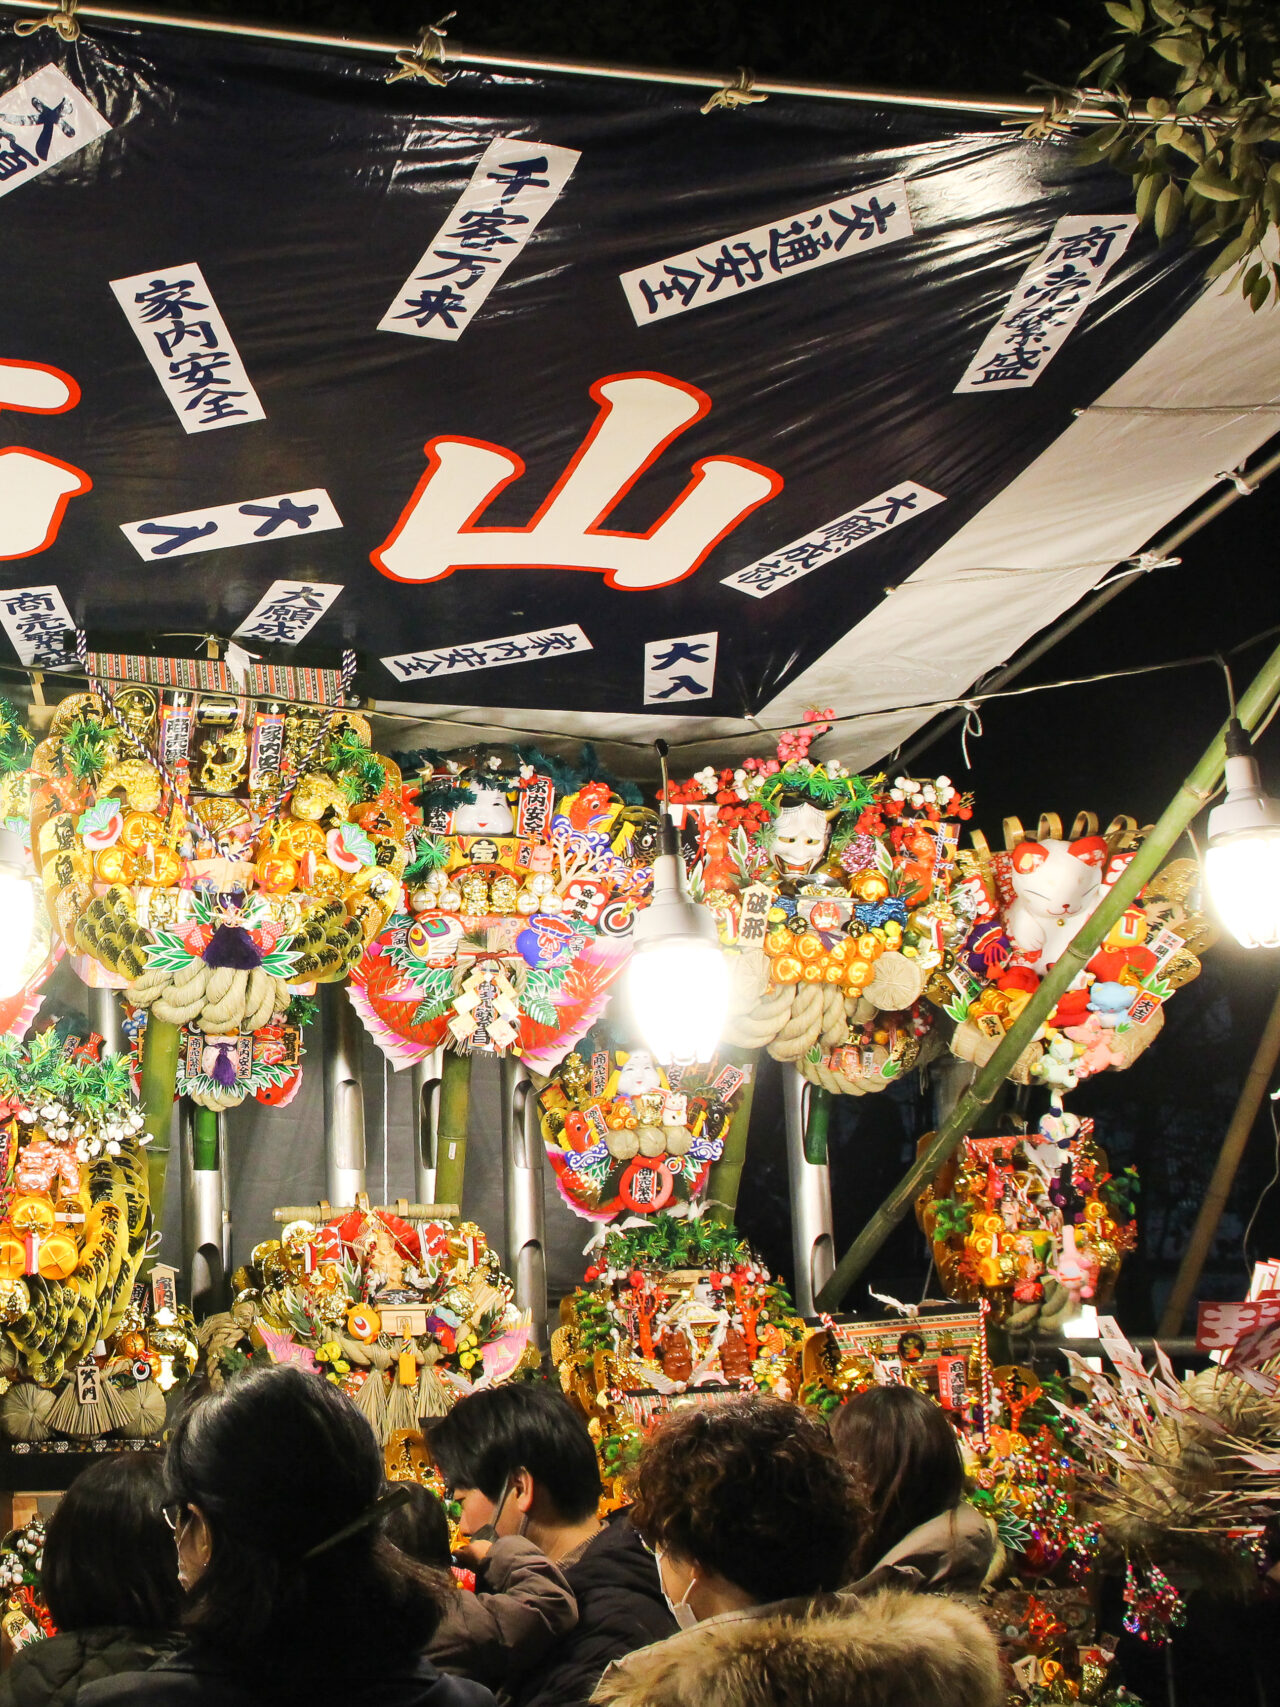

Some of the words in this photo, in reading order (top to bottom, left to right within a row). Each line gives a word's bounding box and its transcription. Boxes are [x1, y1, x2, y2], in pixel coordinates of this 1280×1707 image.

[394, 157, 549, 329] 千客万来
[639, 197, 897, 313] 交通安全
[971, 225, 1127, 387] 商売繁盛
[135, 280, 248, 424] 家内安全
[137, 497, 319, 554] 大入
[737, 491, 919, 591] 大願成就
[1, 592, 84, 670] 商売繁盛
[244, 585, 325, 646] 大願成
[396, 630, 576, 677] 家内安全
[649, 643, 710, 698] 大入
[165, 717, 191, 772] 商売繁
[257, 724, 283, 778] 家内安
[524, 780, 549, 837] 家内安全
[742, 891, 770, 941] 破邪
[1132, 1000, 1153, 1020] 大吉
